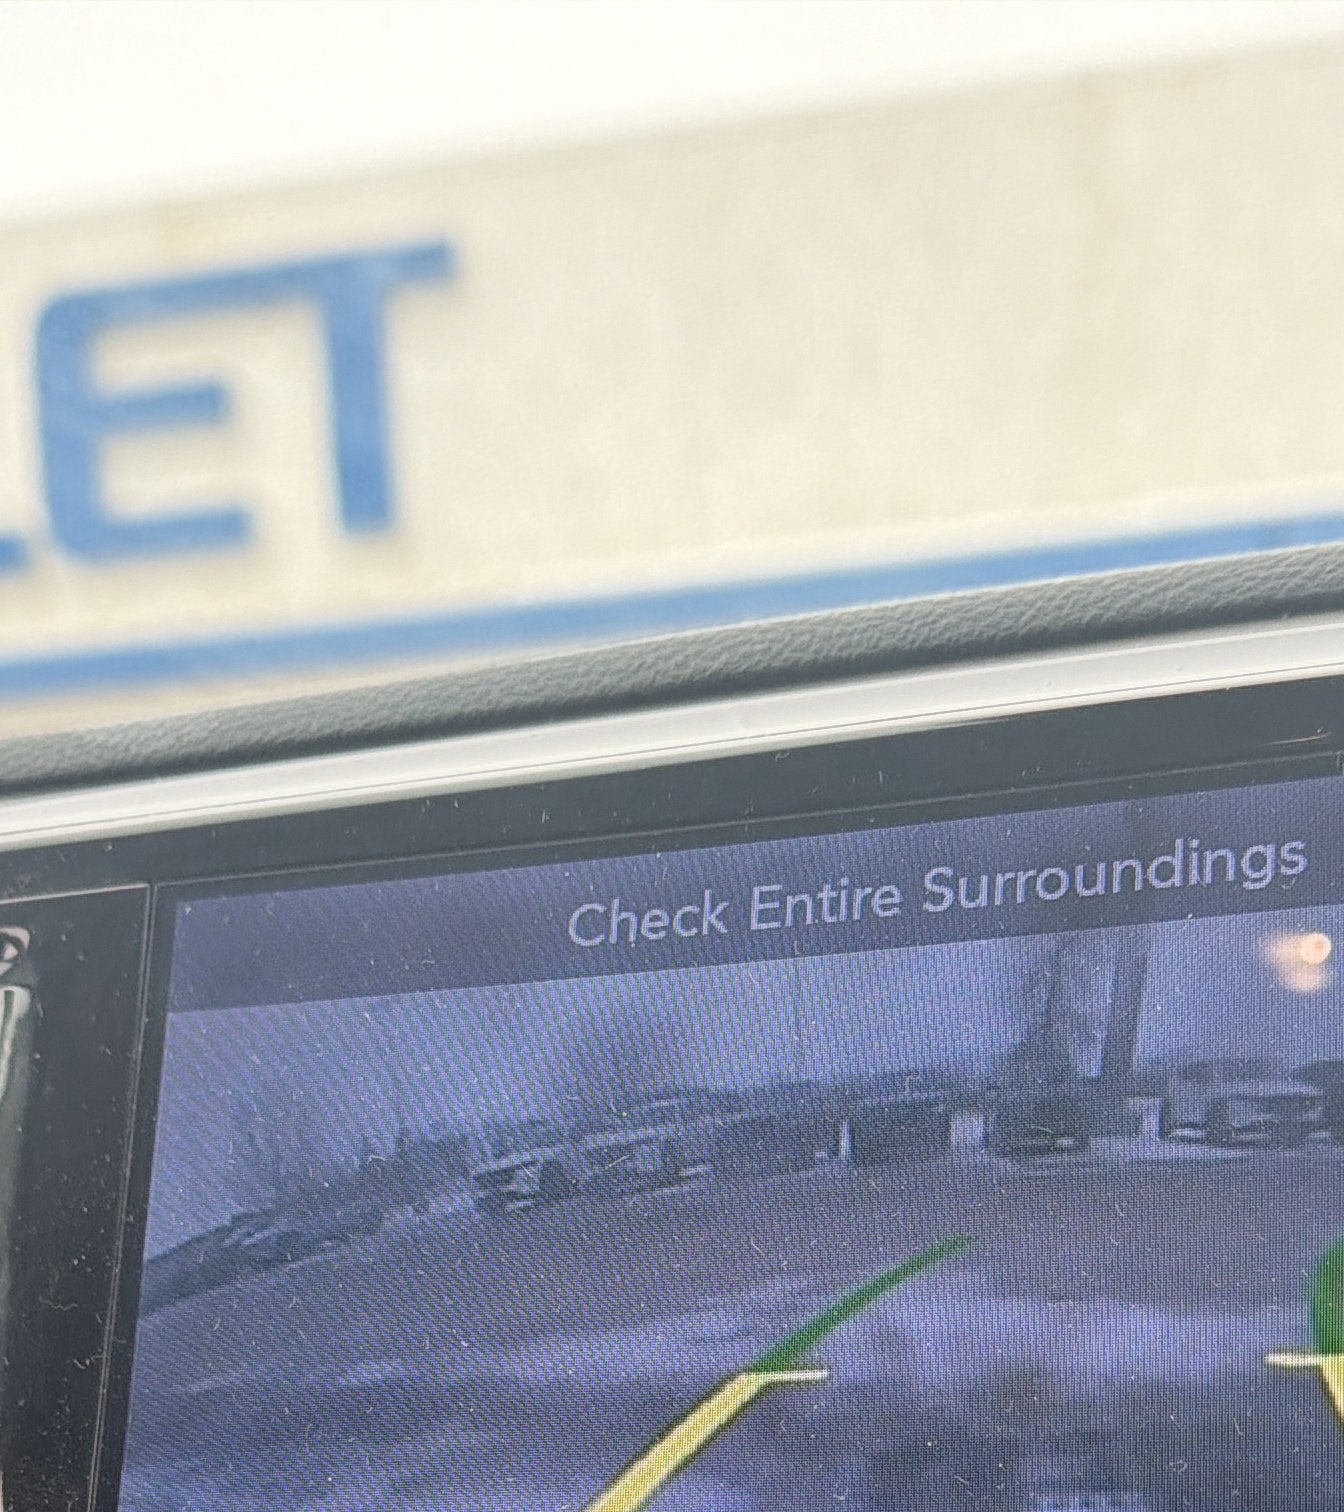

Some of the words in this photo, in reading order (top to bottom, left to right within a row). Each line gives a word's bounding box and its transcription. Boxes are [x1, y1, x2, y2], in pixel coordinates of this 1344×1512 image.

[568, 888, 729, 948] Check
[749, 865, 902, 932] Entire
[921, 832, 1309, 913] Surroundings
